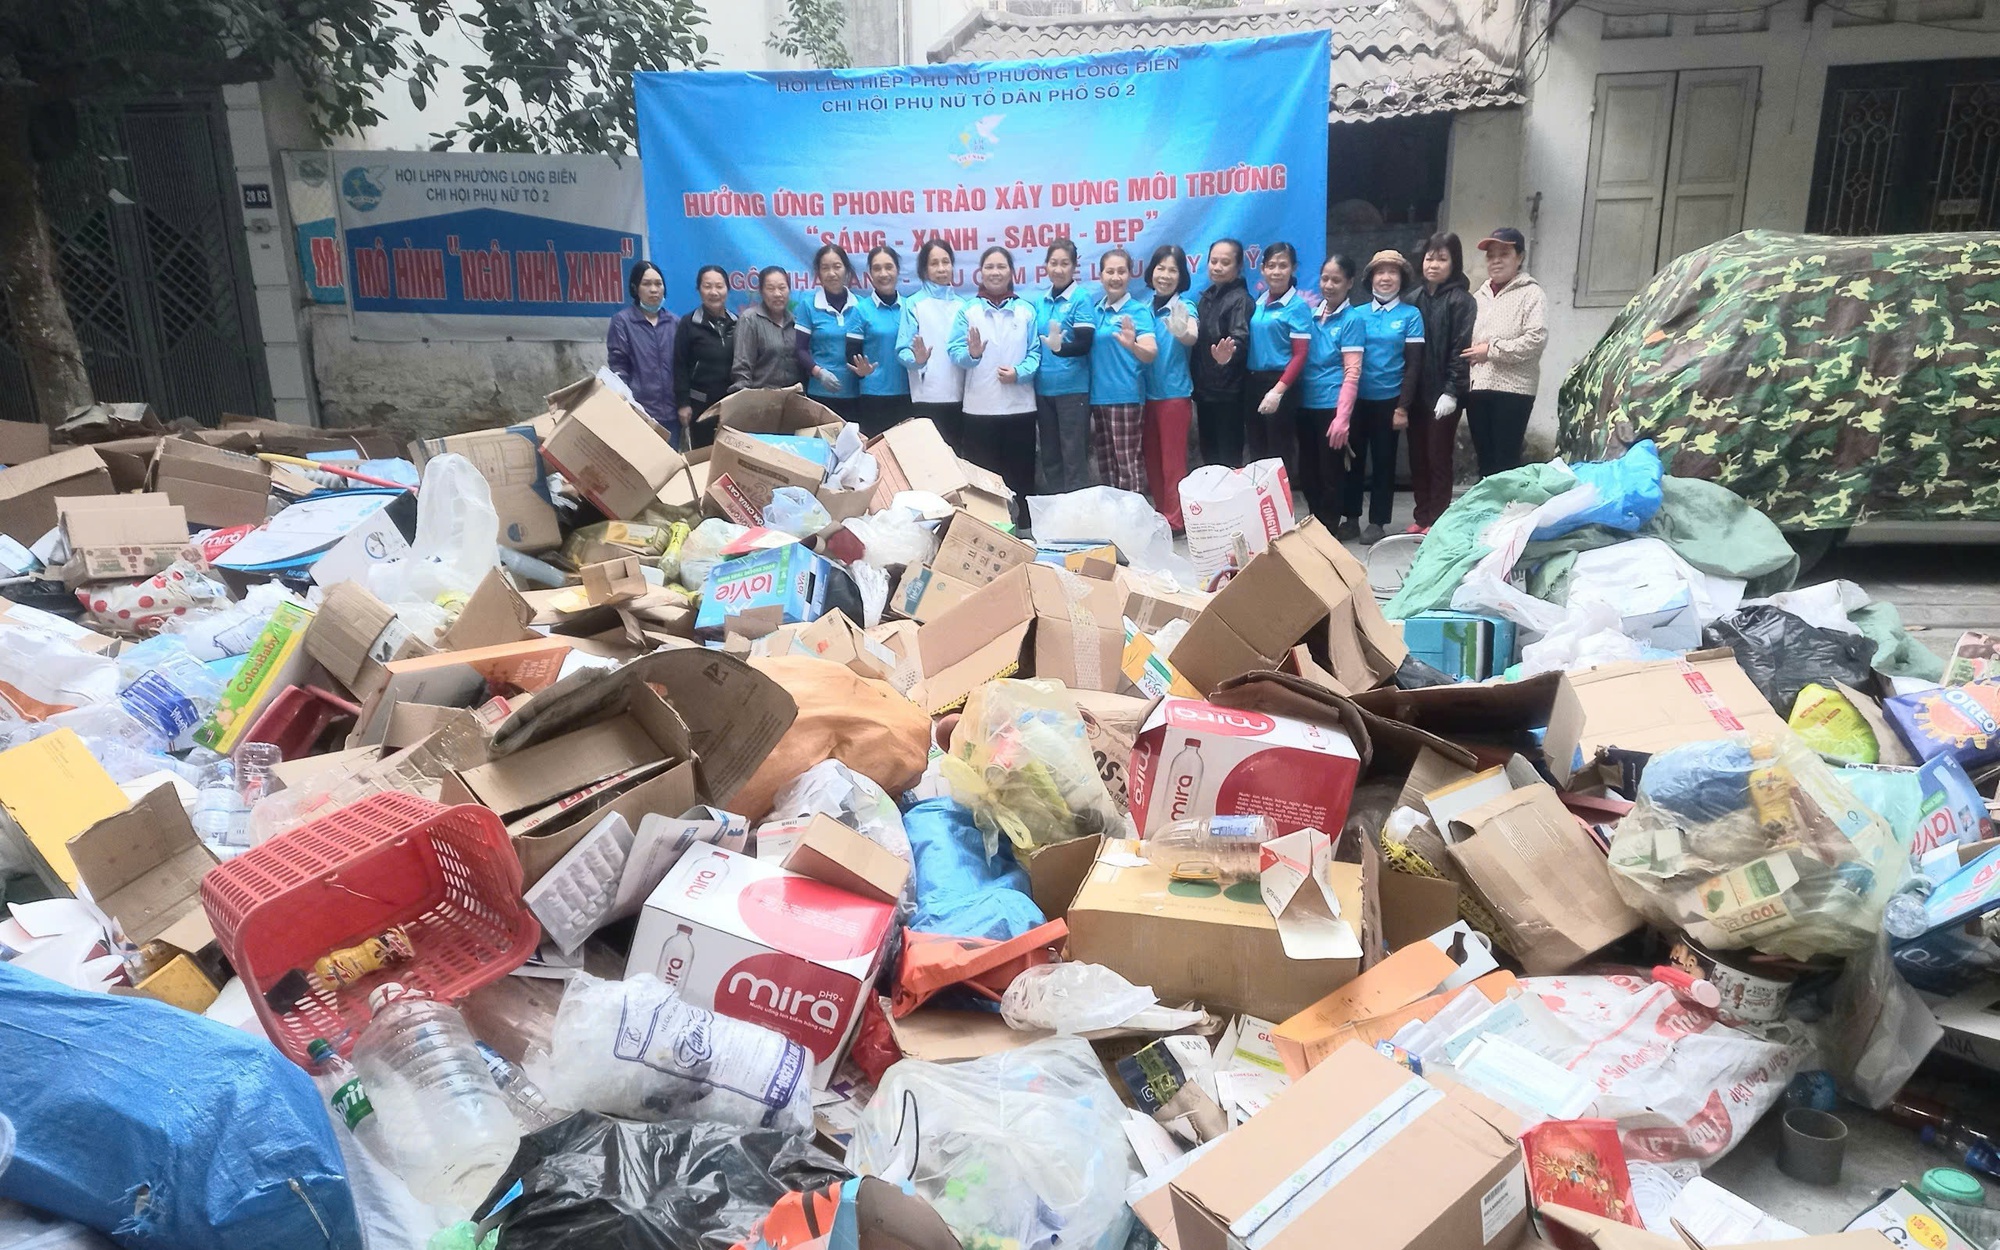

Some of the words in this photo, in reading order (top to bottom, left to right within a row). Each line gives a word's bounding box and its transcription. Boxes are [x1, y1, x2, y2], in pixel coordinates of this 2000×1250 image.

[861, 73, 904, 90] HIỆP
[910, 74, 949, 89] PHỤ
[1075, 62, 1129, 78] LONG
[821, 100, 852, 113] CHI
[857, 95, 888, 113] HỘI
[894, 97, 934, 112] PHỤ
[940, 92, 967, 109] NỮ
[970, 86, 996, 107] TỔ
[1002, 88, 1041, 105] DÂN
[1049, 82, 1089, 102] PHỐ
[1094, 80, 1121, 99] SỐ
[1125, 84, 1136, 96] 2
[395, 168, 416, 186] HỘI
[419, 169, 451, 184] LHPN
[454, 167, 508, 184] PHƯỜNG
[511, 169, 546, 184] LONG
[549, 168, 577, 184] BIÊN
[683, 185, 767, 218] HƯỞNG
[773, 188, 825, 217] ỨNG
[832, 191, 915, 216] PHONG
[922, 184, 986, 213] TRÀO
[995, 180, 1043, 210] XÂY
[1051, 178, 1119, 212] DỰNG
[1127, 171, 1177, 202] MÔI
[1185, 161, 1287, 198] TRƯỜNG
[426, 188, 447, 201] CHI
[449, 186, 471, 205] HỘI
[473, 188, 498, 205] PHỤ
[500, 186, 520, 202] NỮ
[542, 190, 550, 203] 2
[912, 227, 979, 253] XANH
[1004, 222, 1071, 254] SẠCH
[310, 236, 344, 288] M
[355, 237, 390, 298] MÔ
[392, 237, 447, 300] HÌNH
[515, 239, 563, 303] NHÀ
[726, 484, 740, 498] CAY
[738, 497, 755, 515] CHUA
[236, 635, 280, 693] ColosBaby
[513, 659, 532, 683] HAPPY
[525, 658, 541, 678] NEW
[536, 658, 551, 678] YEAR
[1174, 705, 1268, 731] mira
[1942, 689, 1998, 735] OREO
[1170, 774, 1193, 821] mira
[685, 870, 716, 900] mira
[1741, 903, 1778, 924] COOL
[664, 957, 684, 987] ira
[728, 971, 839, 1029] mira
[818, 990, 845, 1002] pH9+
[1748, 1067, 1770, 1088] Cao
